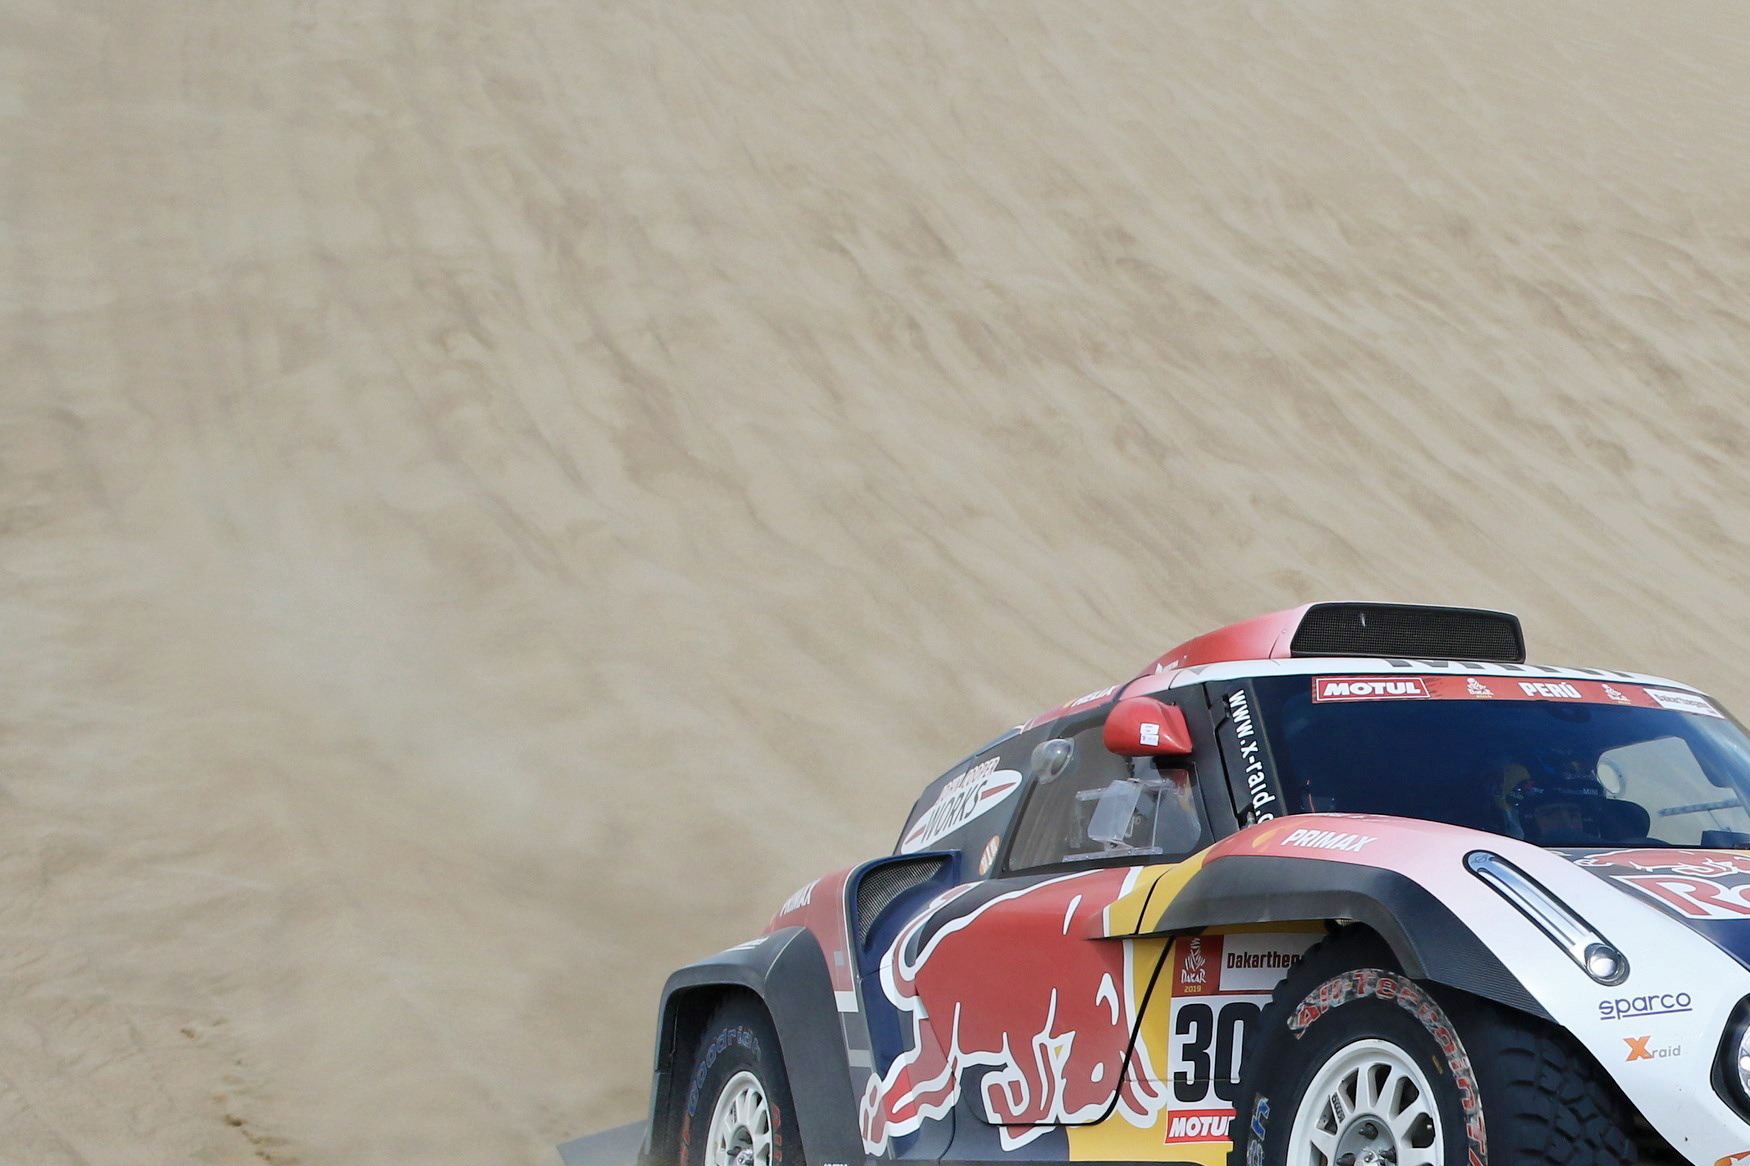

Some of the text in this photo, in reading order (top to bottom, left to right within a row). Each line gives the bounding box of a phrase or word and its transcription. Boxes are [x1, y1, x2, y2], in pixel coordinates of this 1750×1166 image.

[1323, 681, 1422, 696] MOTUL
[1518, 681, 1582, 698] PERÚ
[921, 780, 988, 843] WORKS
[1280, 828, 1378, 853] PRIMAX
[1181, 968, 1207, 984] DAKAR
[1184, 985, 1201, 993] 2019
[1599, 992, 1693, 1021] sparco
[1173, 1002, 1262, 1103] 30
